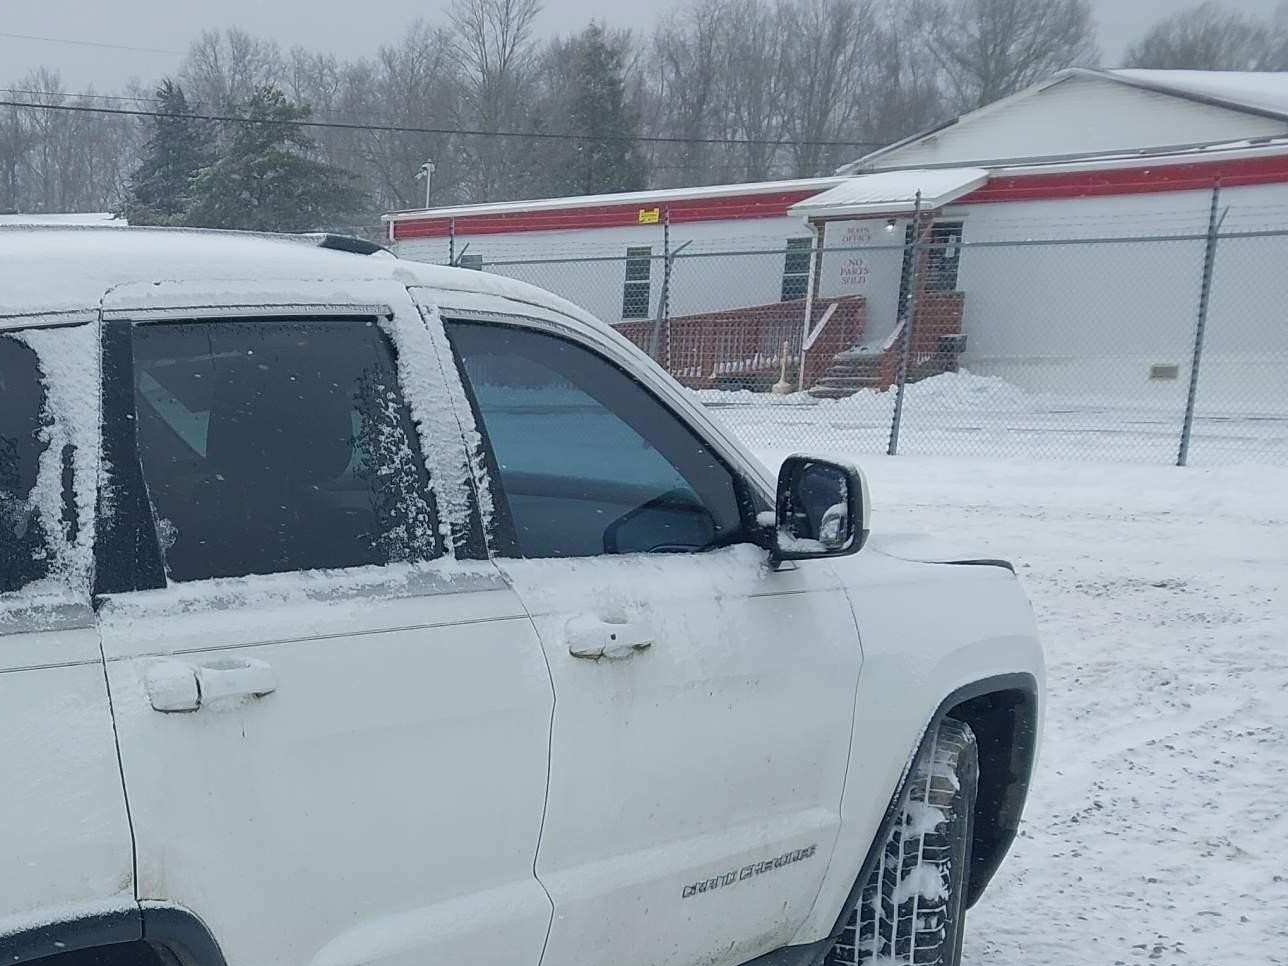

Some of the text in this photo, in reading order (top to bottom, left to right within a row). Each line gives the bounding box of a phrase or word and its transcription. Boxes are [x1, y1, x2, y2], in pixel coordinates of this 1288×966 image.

[848, 258, 864, 266] NO
[840, 266, 870, 275] PARTS
[840, 275, 866, 285] SOLD
[681, 870, 738, 898] GRAND
